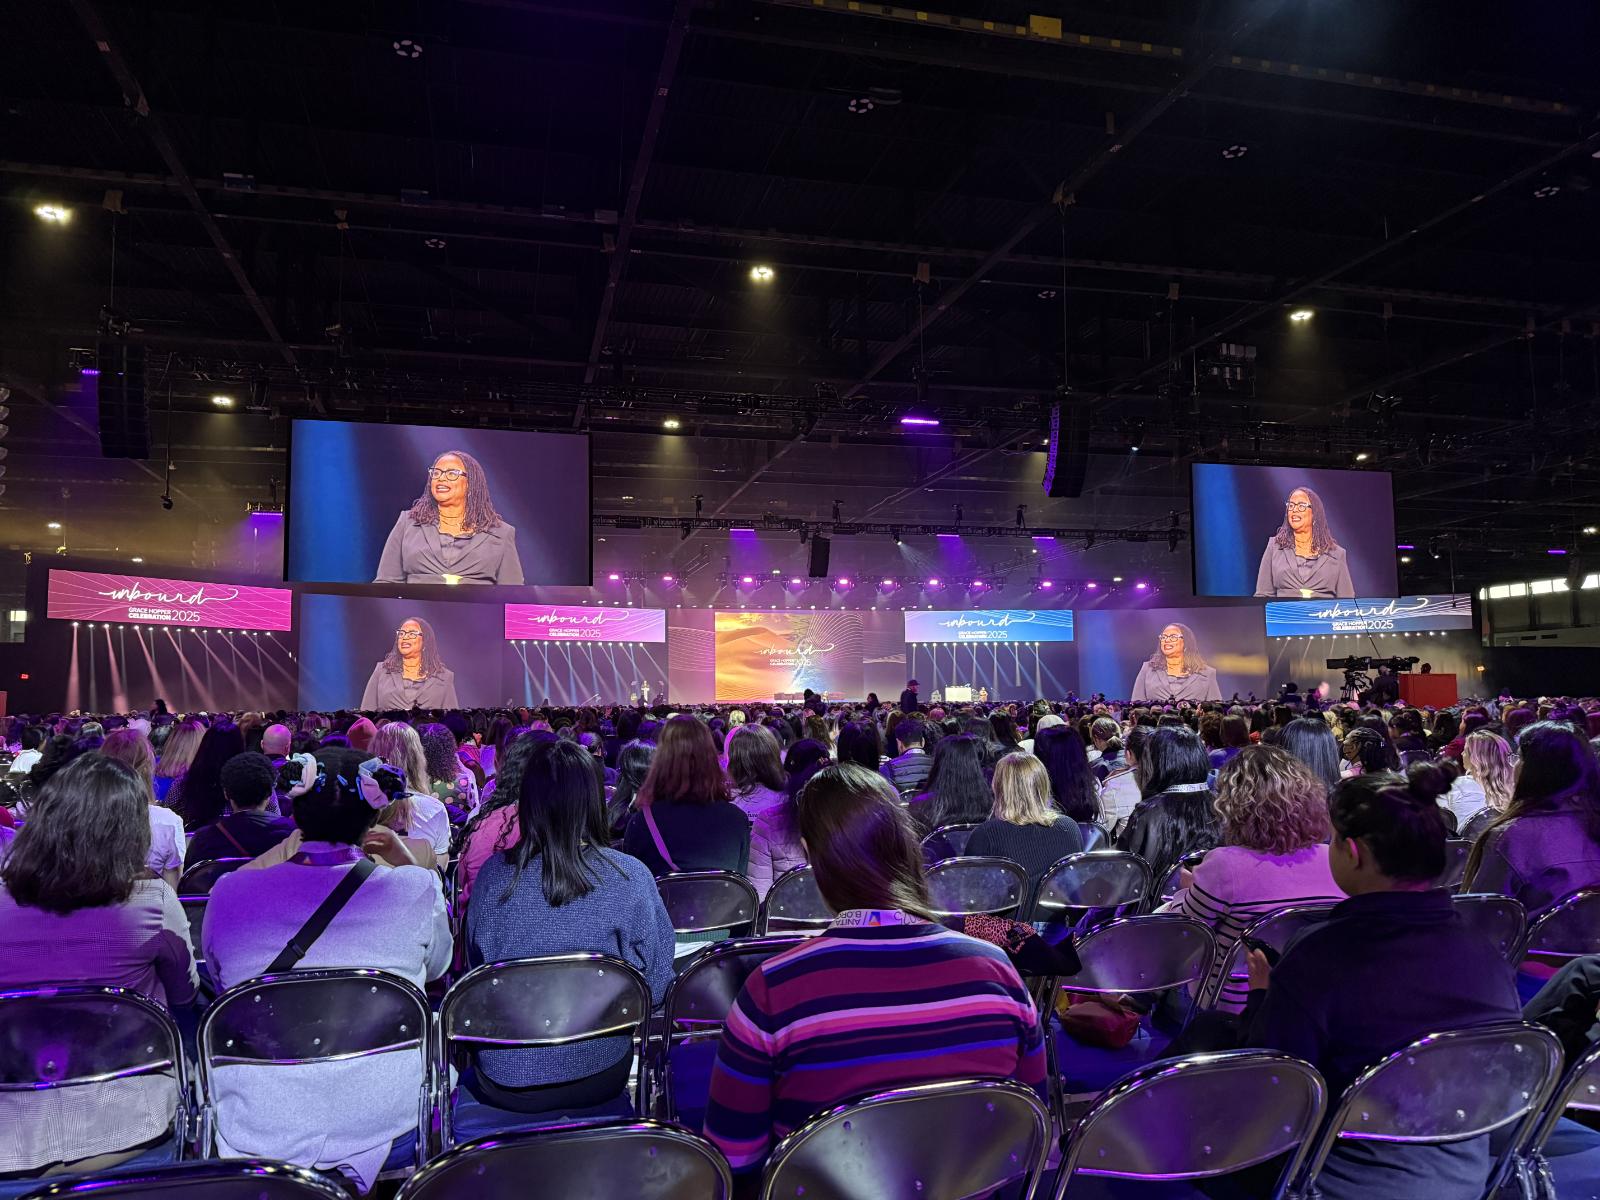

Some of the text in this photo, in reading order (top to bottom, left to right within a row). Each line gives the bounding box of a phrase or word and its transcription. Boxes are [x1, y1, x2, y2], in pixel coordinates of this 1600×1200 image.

[128, 606, 149, 614] GRACE
[128, 609, 201, 622] CELEBRATION 2025
[1367, 619, 1394, 630] 2025
[580, 629, 602, 638] 2025
[988, 630, 1008, 639] 2025
[835, 919, 862, 927] ANITA
